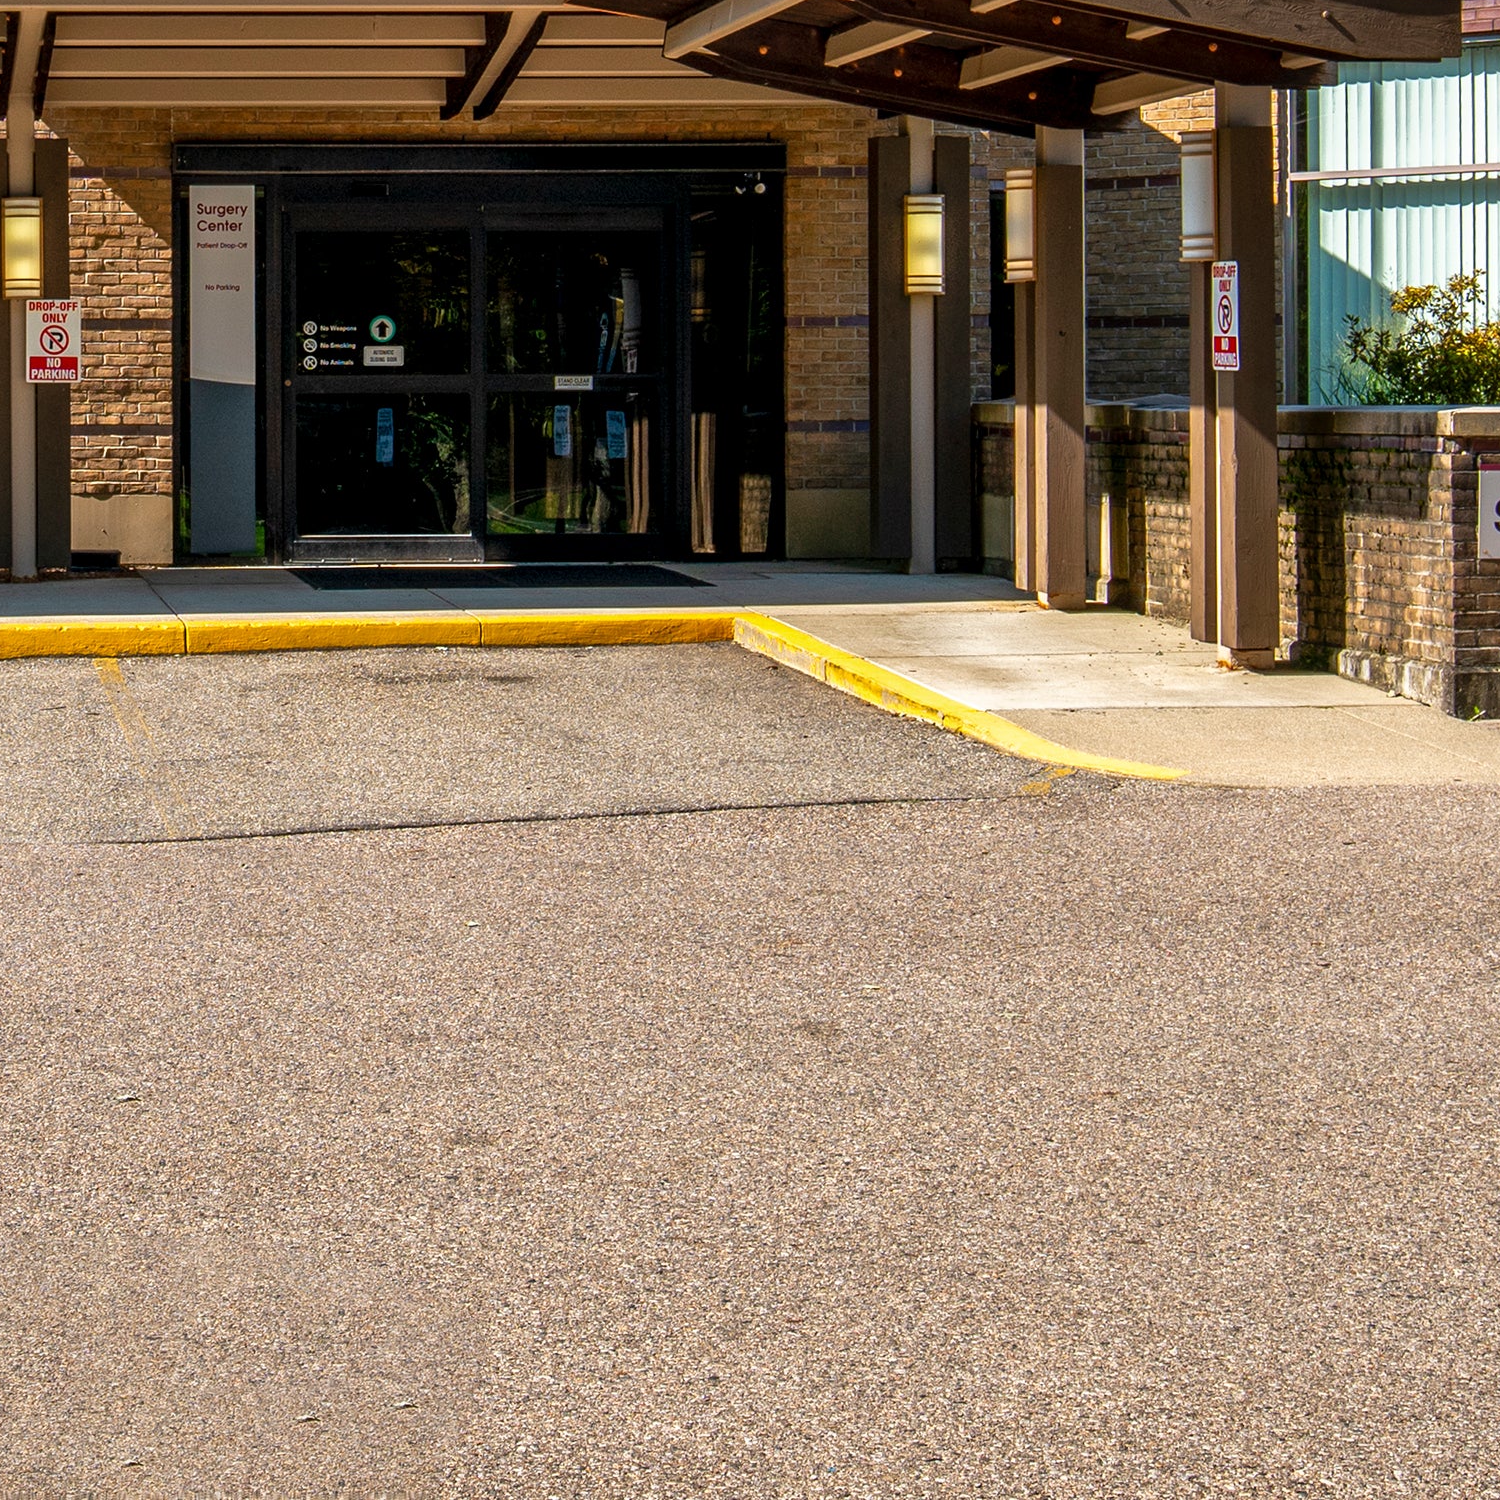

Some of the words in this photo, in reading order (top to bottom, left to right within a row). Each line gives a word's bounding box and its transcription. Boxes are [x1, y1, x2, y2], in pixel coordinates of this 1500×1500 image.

[196, 203, 248, 218] Surgery
[197, 220, 243, 231] Center
[216, 284, 240, 292] Parking
[28, 301, 78, 311] DROP-OFF
[42, 313, 68, 323] ONLY
[46, 358, 61, 368] NO
[31, 369, 76, 379] PARKING
